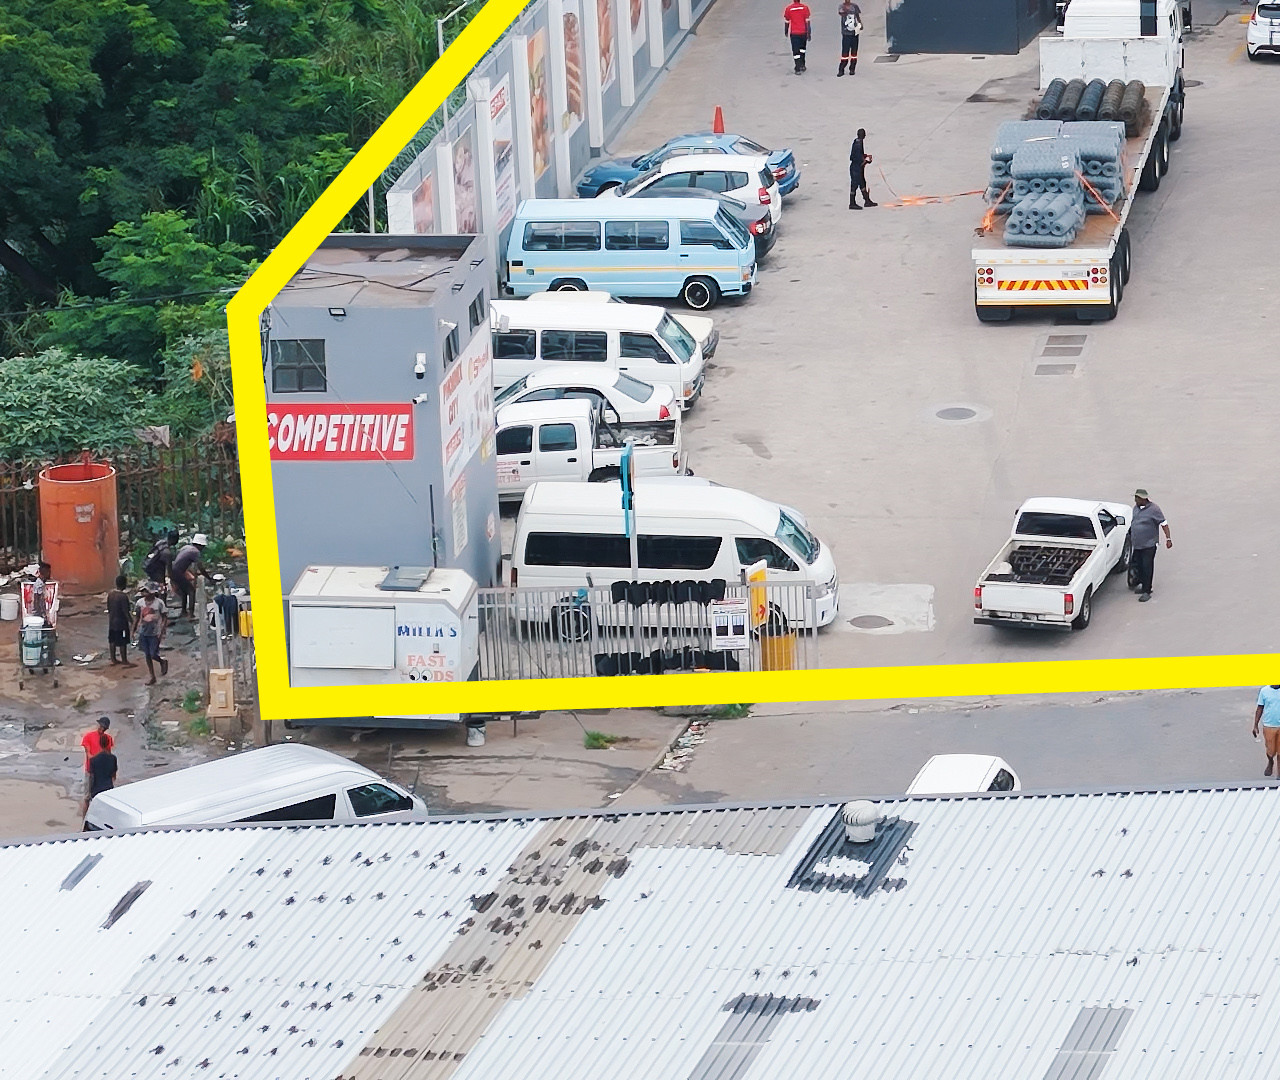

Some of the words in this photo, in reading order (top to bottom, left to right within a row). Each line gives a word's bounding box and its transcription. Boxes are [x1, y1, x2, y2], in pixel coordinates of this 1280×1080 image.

[448, 394, 459, 425] CITY
[267, 412, 410, 453] COMPETITIVE
[407, 654, 446, 667] FAST
